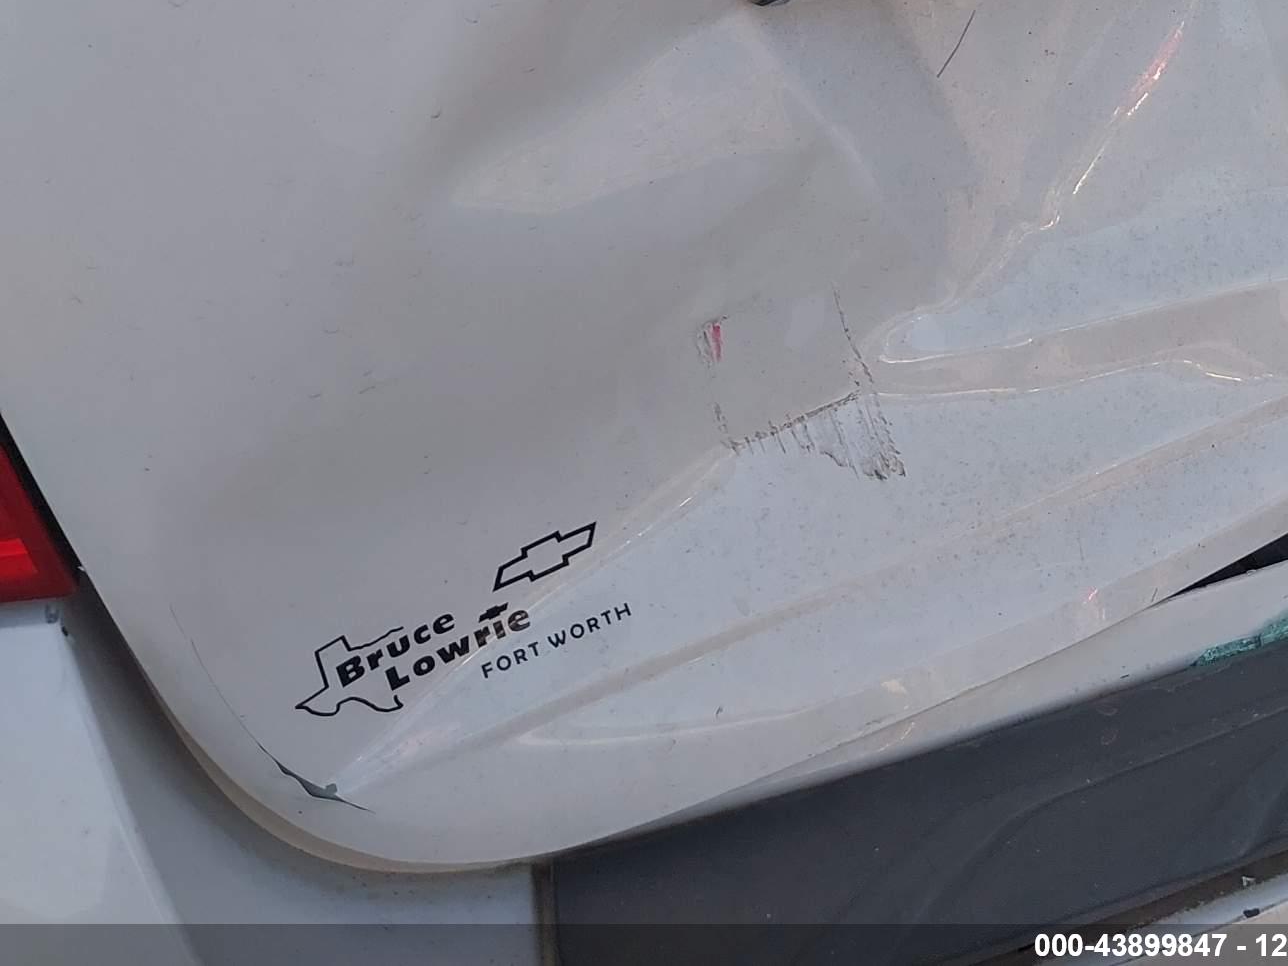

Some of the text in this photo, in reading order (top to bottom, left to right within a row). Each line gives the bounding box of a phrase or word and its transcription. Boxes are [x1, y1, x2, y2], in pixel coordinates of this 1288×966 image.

[336, 613, 456, 688] Bruce
[385, 608, 531, 691] Lowrie
[481, 602, 633, 679] FORT WORTH
